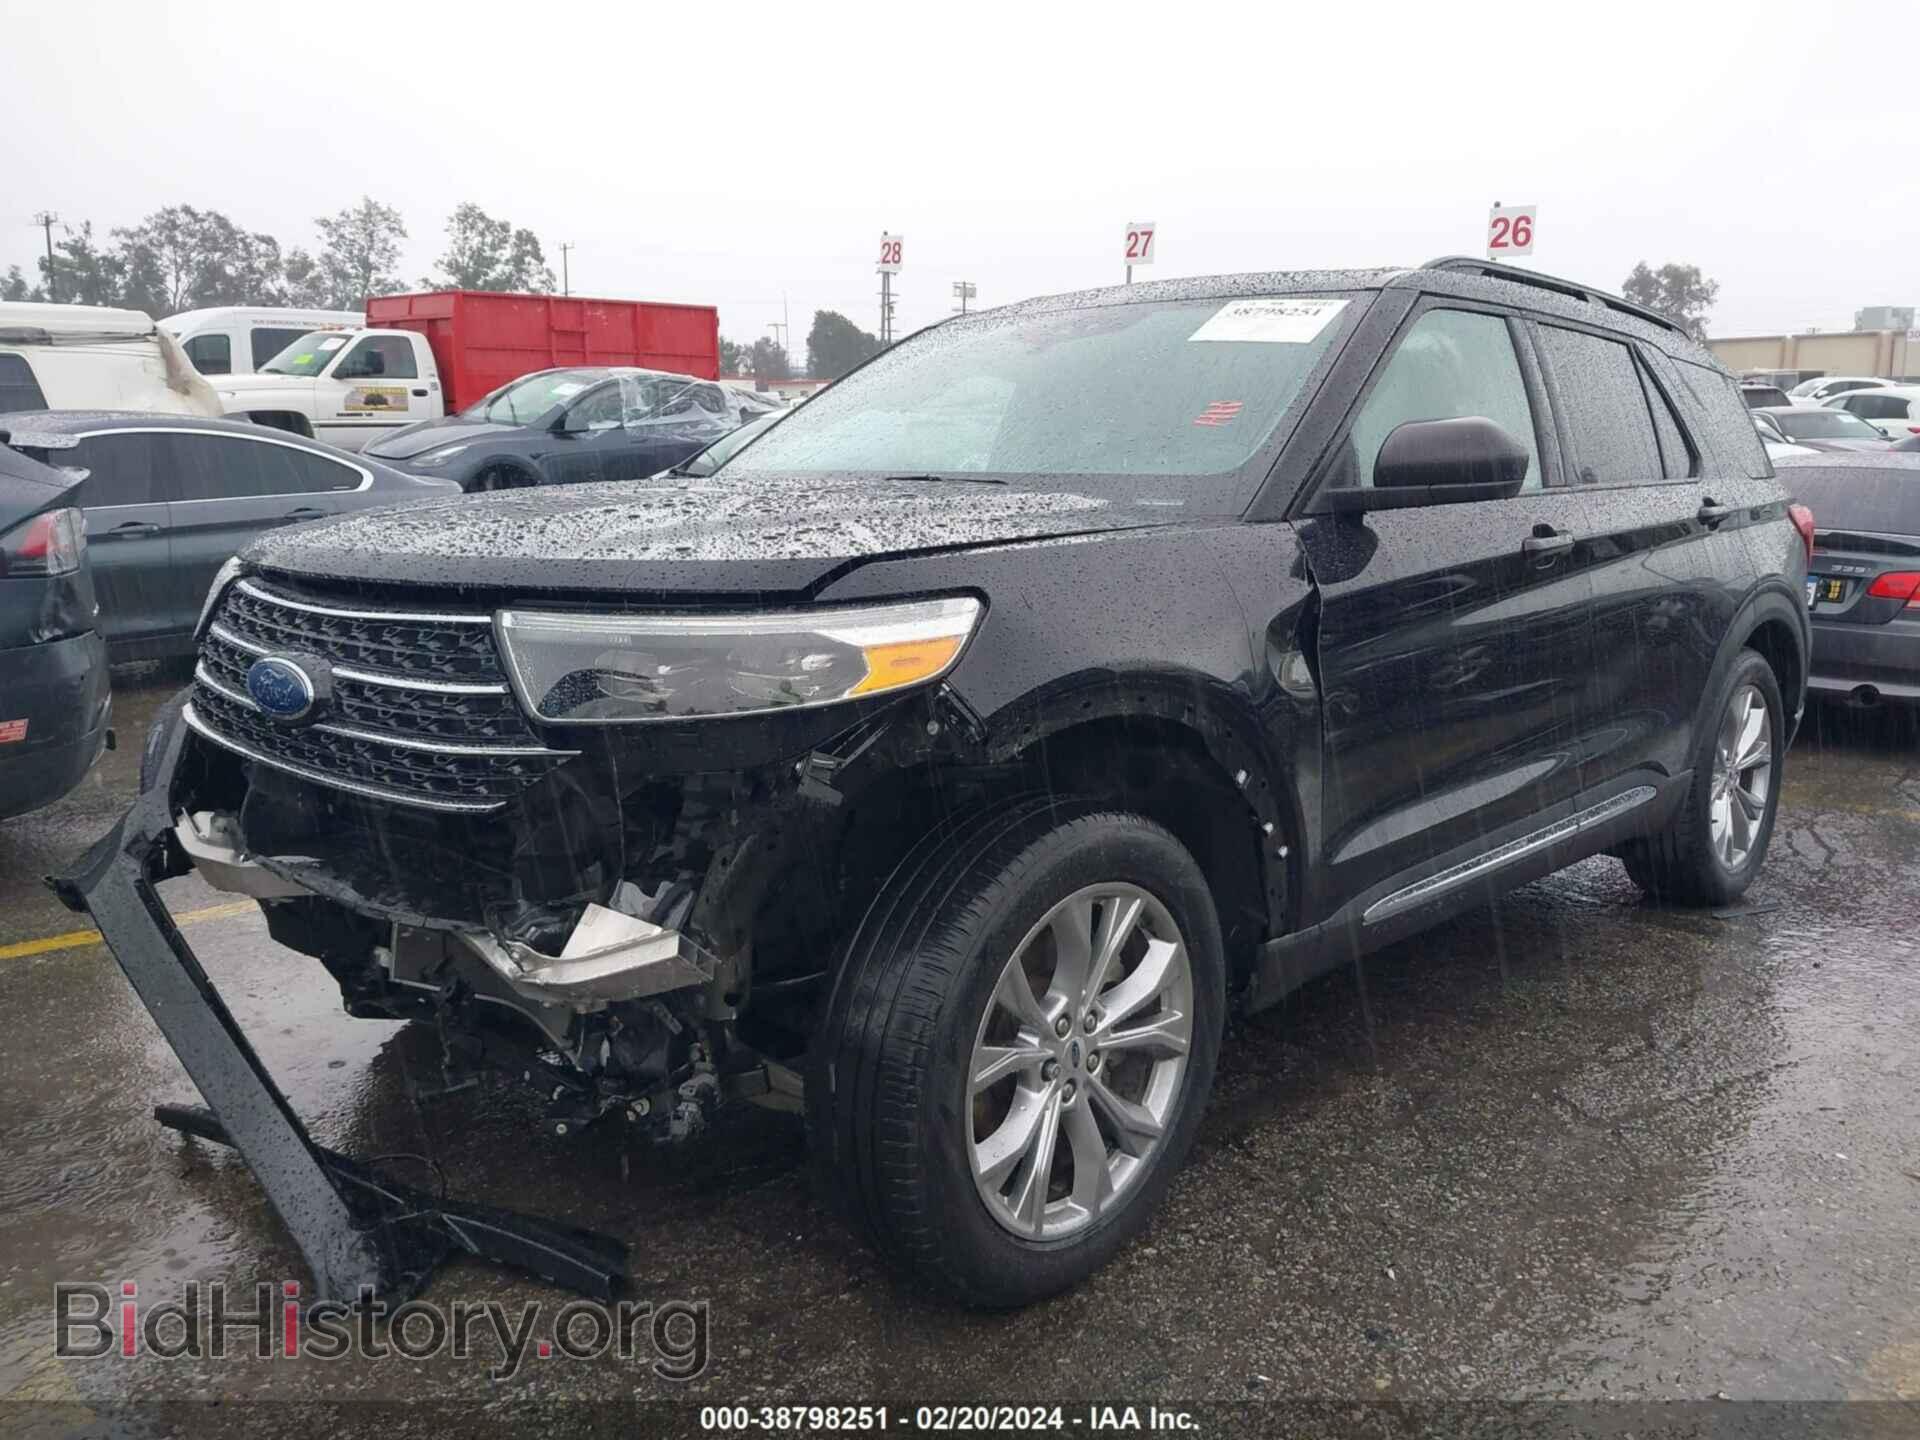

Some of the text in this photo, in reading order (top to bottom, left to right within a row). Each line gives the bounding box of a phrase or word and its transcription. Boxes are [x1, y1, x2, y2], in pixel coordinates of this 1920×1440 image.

[1126, 231, 1153, 257] 27
[1490, 215, 1532, 248] 26
[881, 242, 901, 264] 28
